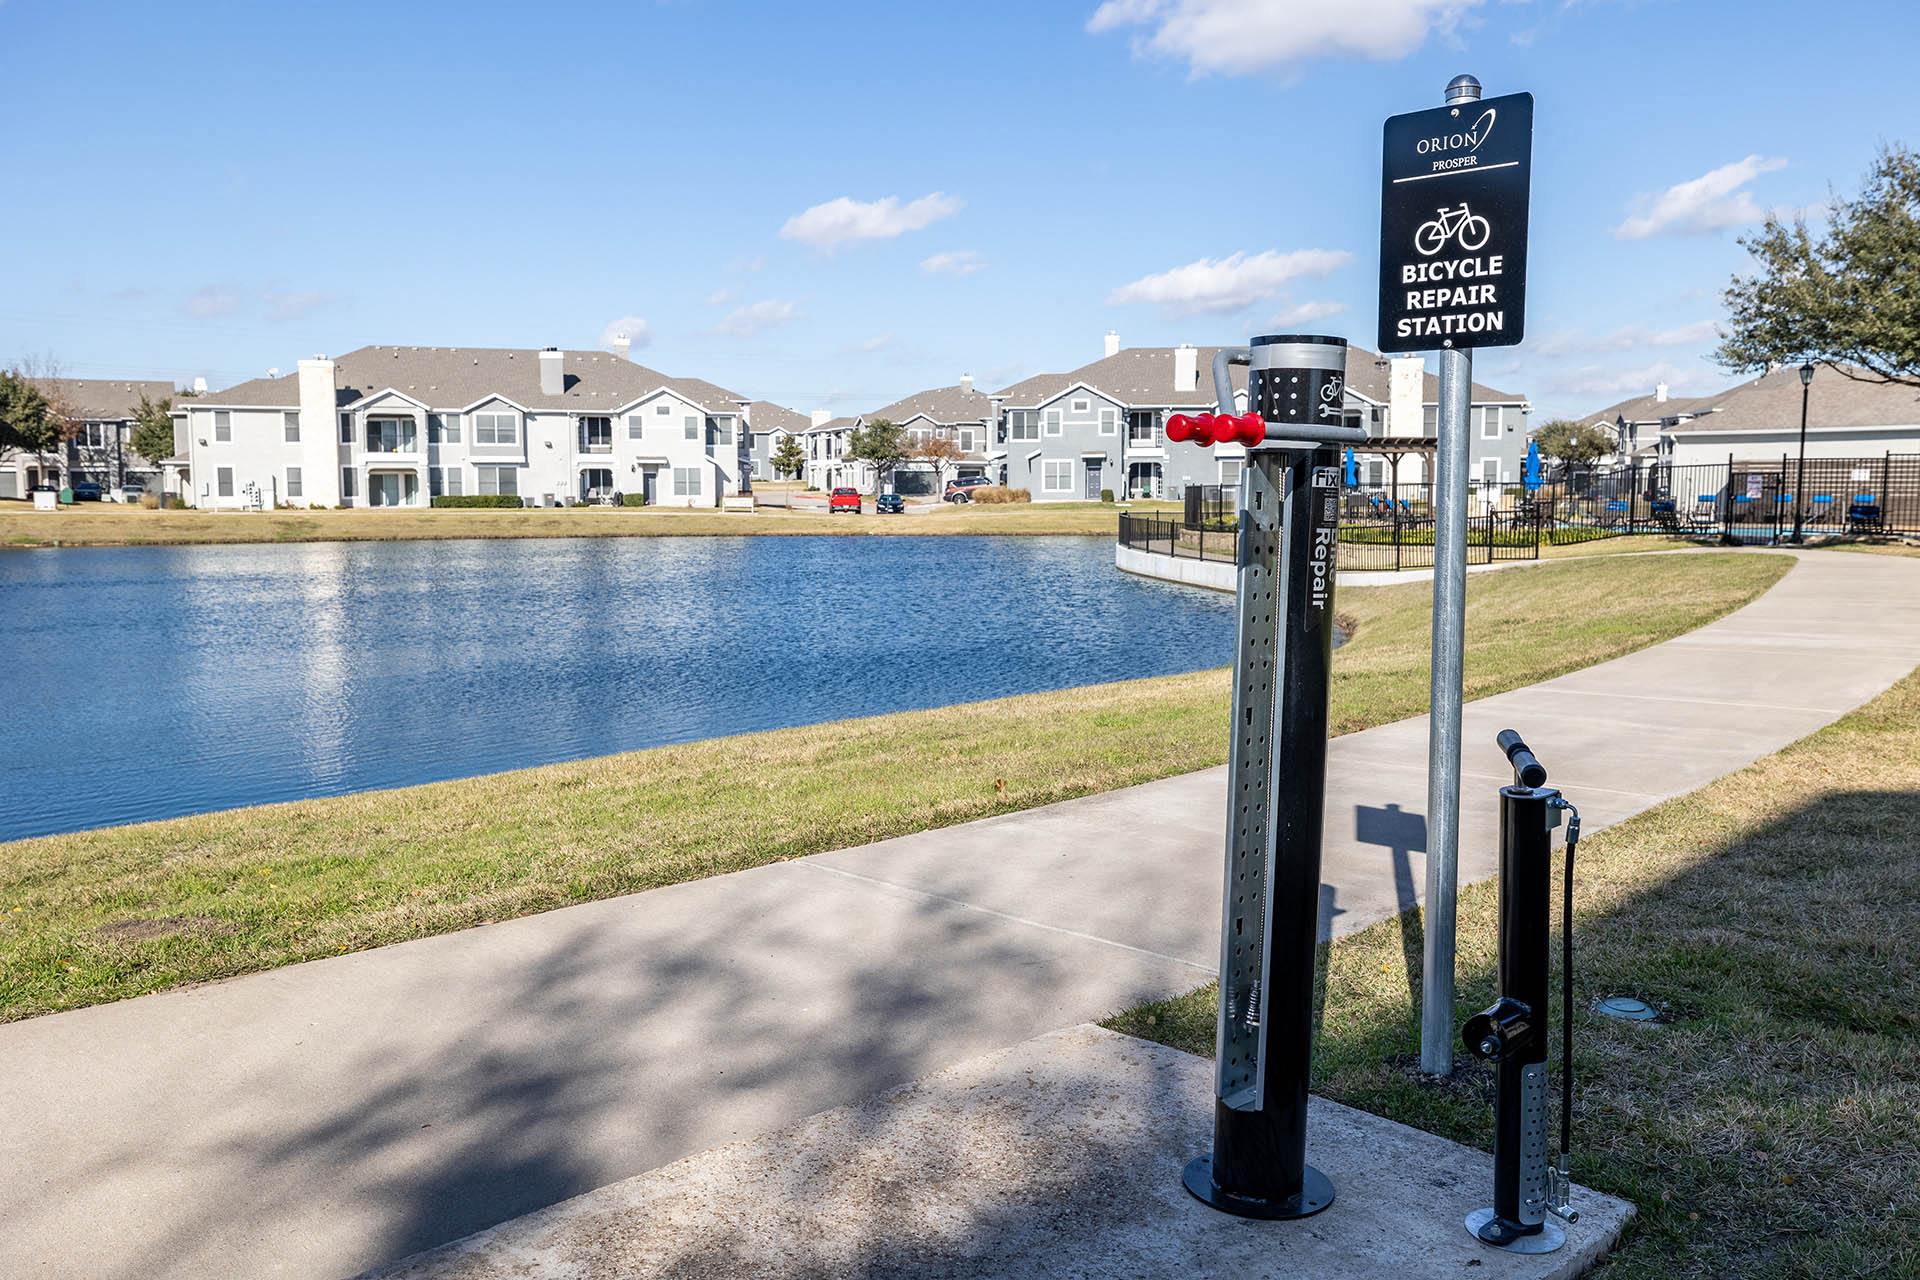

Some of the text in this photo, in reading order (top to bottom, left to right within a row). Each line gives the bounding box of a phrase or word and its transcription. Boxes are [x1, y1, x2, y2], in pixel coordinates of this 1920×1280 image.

[1417, 131, 1477, 154] ORION
[1432, 155, 1478, 171] PROSPER
[1402, 255, 1503, 284] BICYCLE
[1406, 284, 1497, 310] REPAIR
[1397, 311, 1503, 338] STATION
[1310, 527, 1331, 610] Repair
